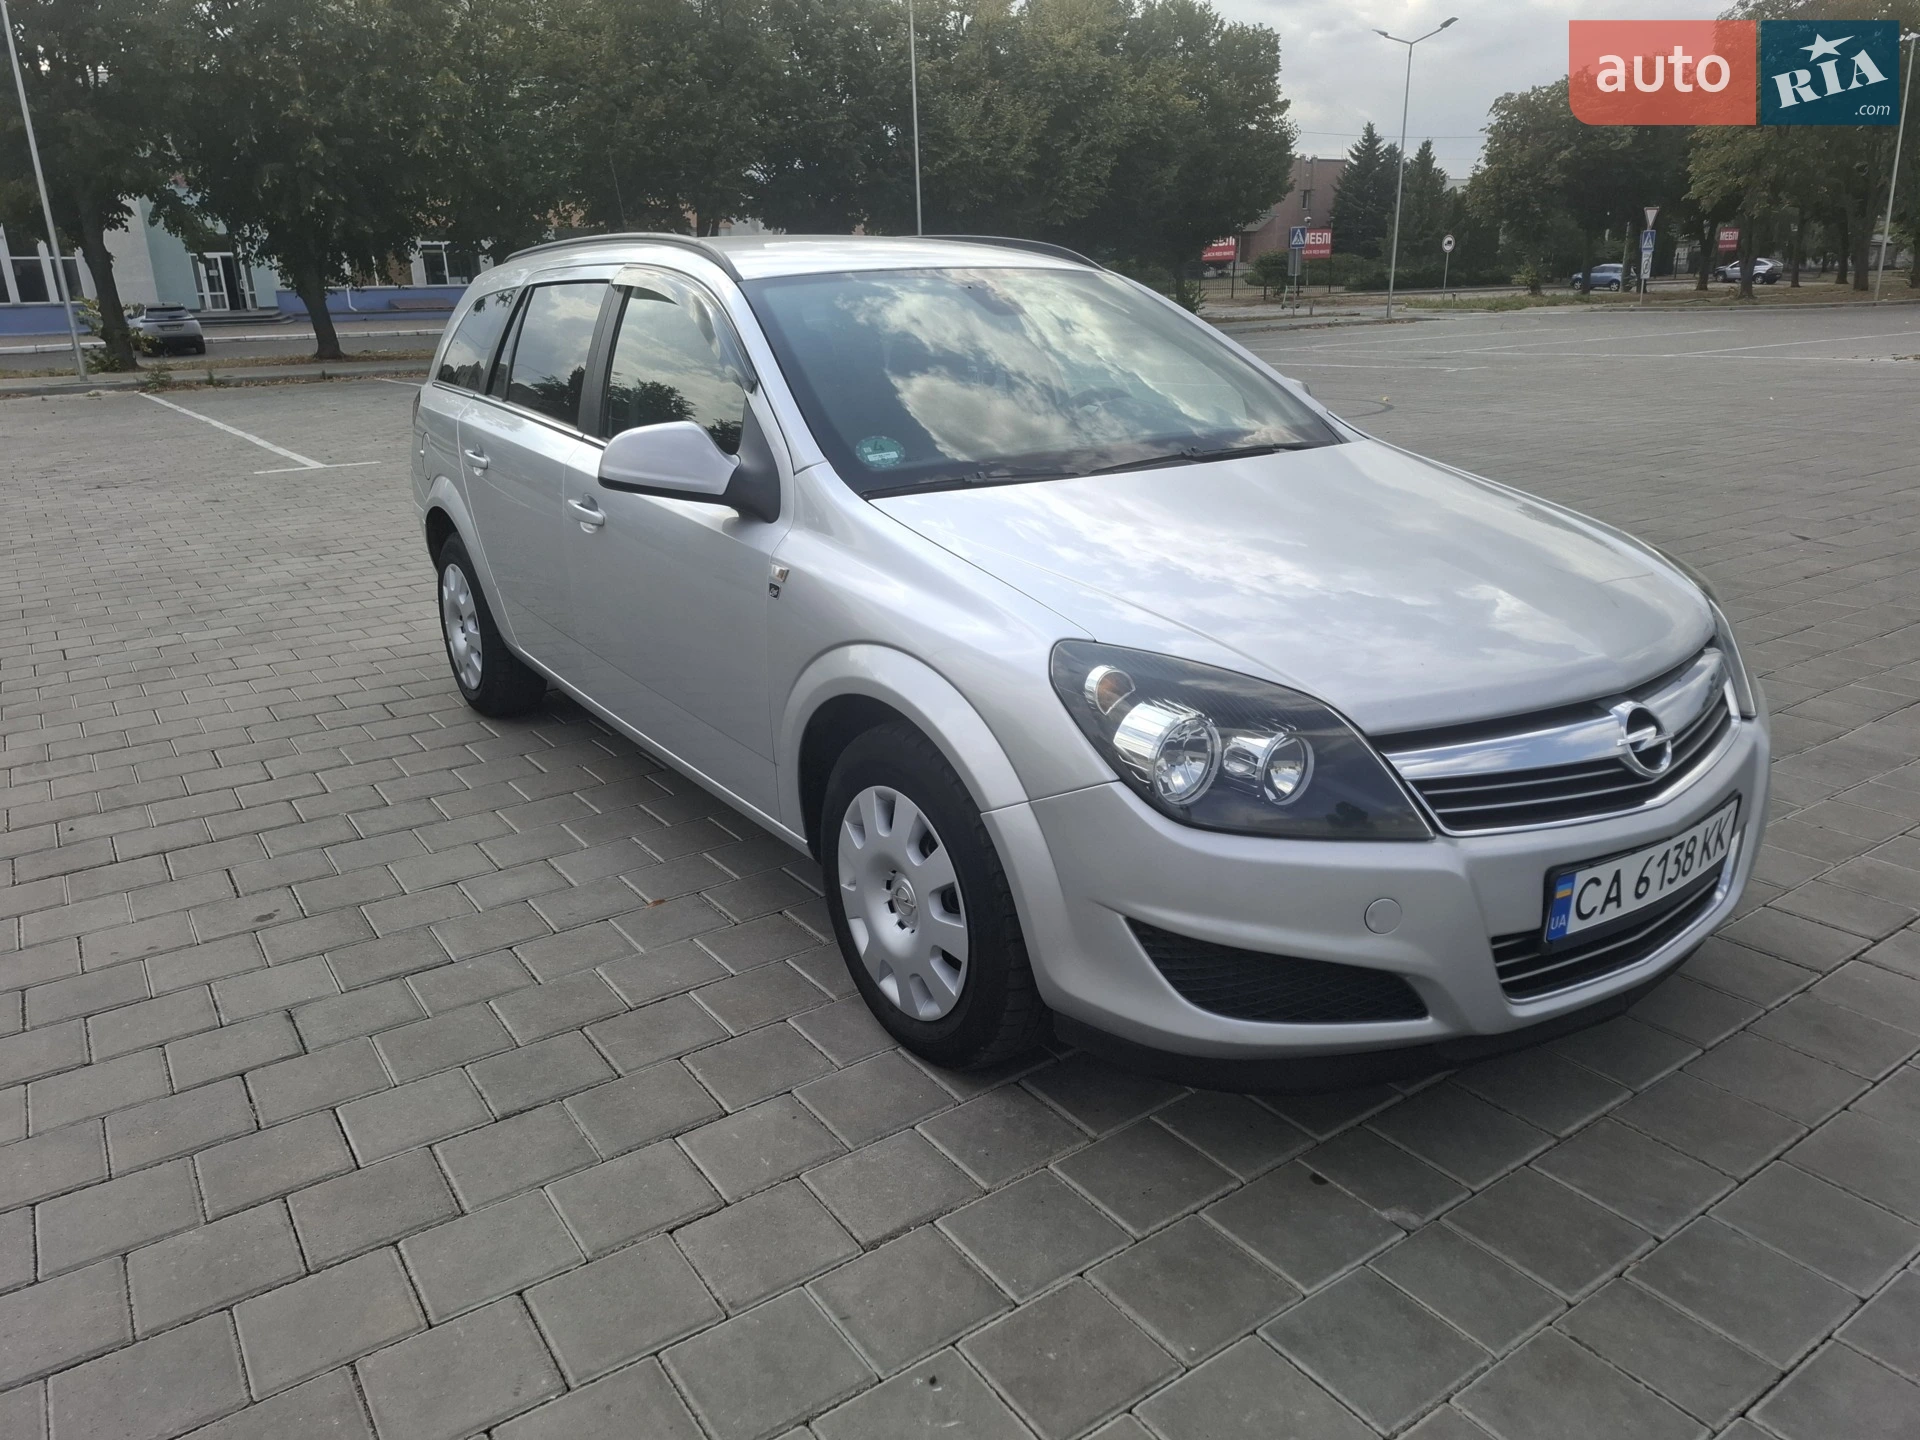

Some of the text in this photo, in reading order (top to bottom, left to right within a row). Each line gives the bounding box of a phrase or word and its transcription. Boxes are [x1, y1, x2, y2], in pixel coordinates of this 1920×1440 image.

[1575, 810, 1733, 921] CA 6138 KK
[1551, 914, 1567, 930] UA
